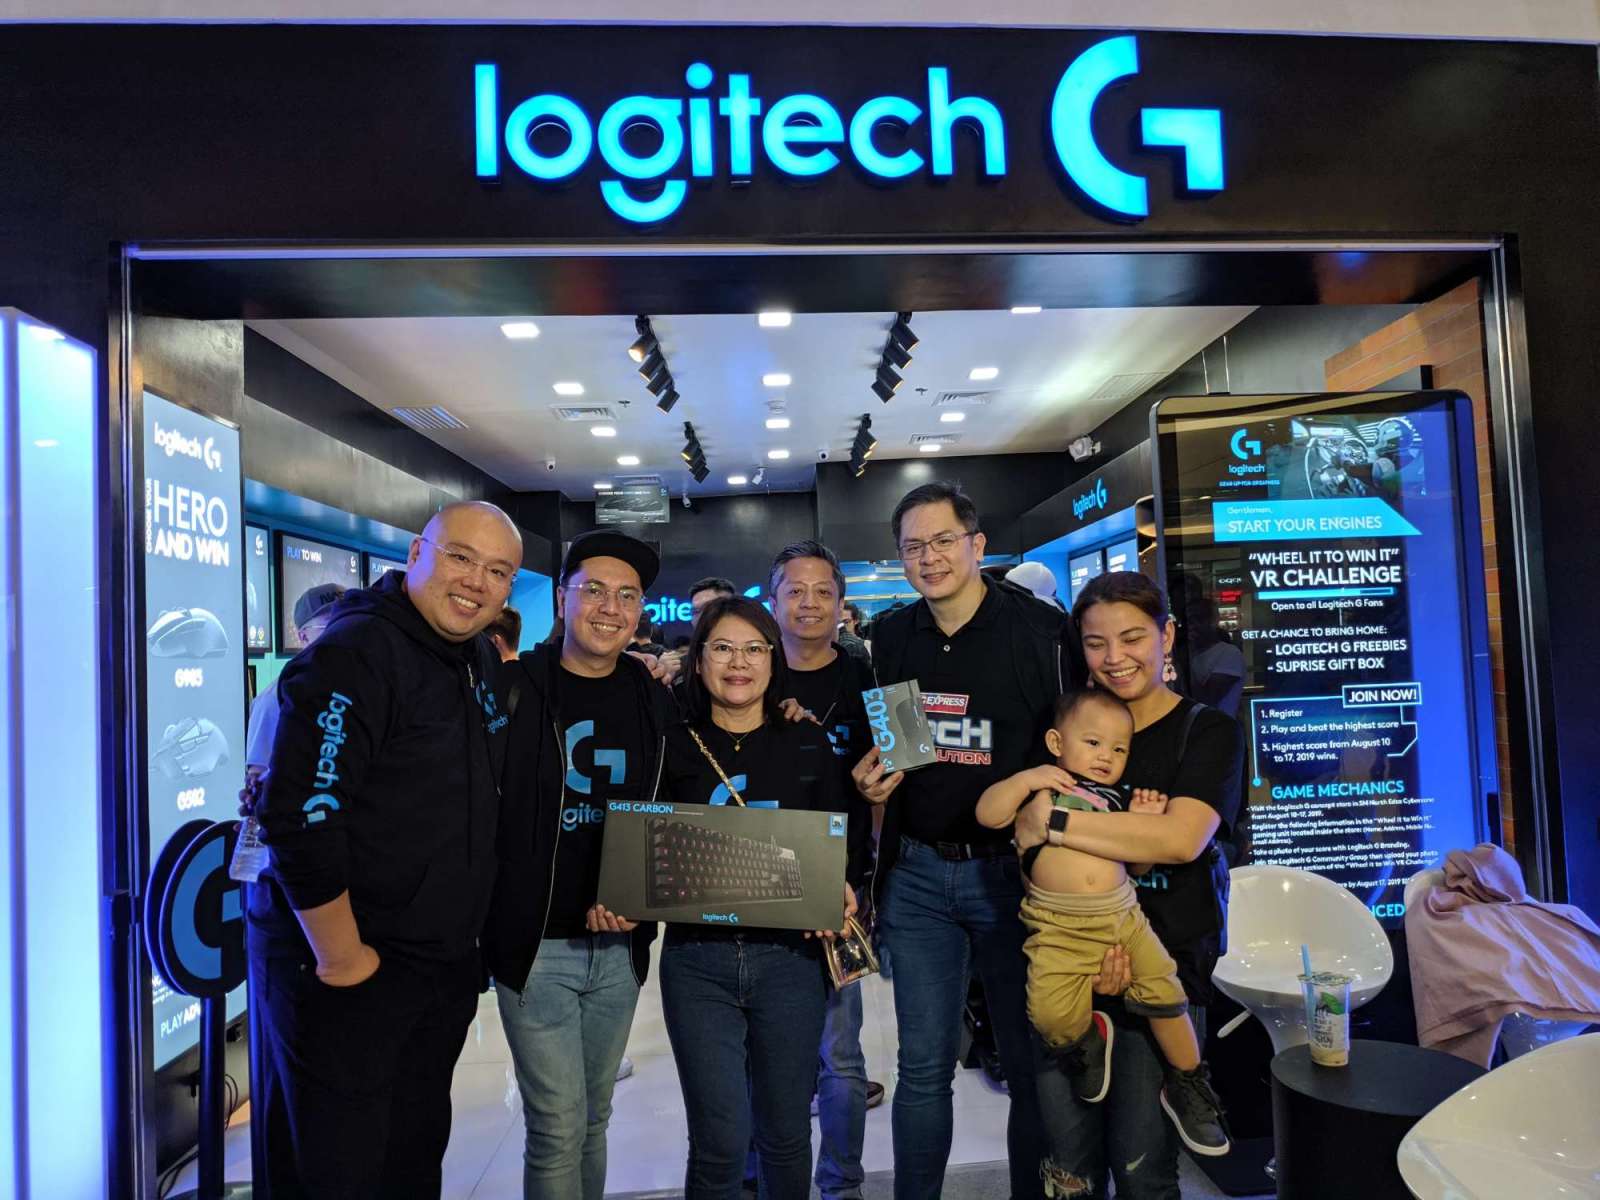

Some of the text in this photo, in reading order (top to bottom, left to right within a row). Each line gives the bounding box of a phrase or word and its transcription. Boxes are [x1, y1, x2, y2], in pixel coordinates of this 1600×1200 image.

[474, 35, 1225, 224] logitech G
[154, 421, 202, 460] logitech
[1228, 463, 1266, 476] logitech
[153, 479, 229, 537] HERO
[1072, 489, 1096, 520] logitech
[1227, 516, 1383, 533] START YOUR ENGINES
[154, 529, 230, 567] AND WIN
[301, 548, 310, 561] TO
[1309, 551, 1321, 563] IT
[1323, 550, 1344, 563] TO
[1346, 549, 1376, 562] WIN
[1250, 565, 1402, 588] VR CHALLENGE
[1271, 599, 1384, 612] Open to all Logitech G Fans
[1241, 625, 1388, 640] GET A CHANCE TO BRING HOME:
[1275, 639, 1407, 656] LOGITECH G FREEBIES
[1275, 657, 1385, 673] SUPRISE GIFT BOX
[926, 695, 966, 706] EXPRESS
[1348, 688, 1417, 703] JOIN NOW!
[1268, 709, 1304, 720] Register
[1270, 724, 1288, 735] Play
[1289, 724, 1307, 733] and
[1307, 723, 1328, 732] beat
[1329, 722, 1343, 731] the
[1344, 721, 1376, 732] highest
[1377, 721, 1400, 729] score
[313, 691, 353, 789] logitech
[1271, 742, 1304, 753] Highest
[1305, 742, 1328, 750] score
[1329, 740, 1350, 749] from
[1351, 738, 1380, 749] August
[1381, 738, 1391, 746] 10
[1274, 754, 1284, 763] to
[1296, 753, 1315, 761] 2019
[1316, 752, 1339, 761] wins.
[1271, 780, 1405, 799] GAME MECHANICS
[608, 802, 674, 815] G413 CARBON
[1356, 880, 1378, 889] August
[702, 913, 728, 923] logitech
[160, 1010, 184, 1039] PLAY
